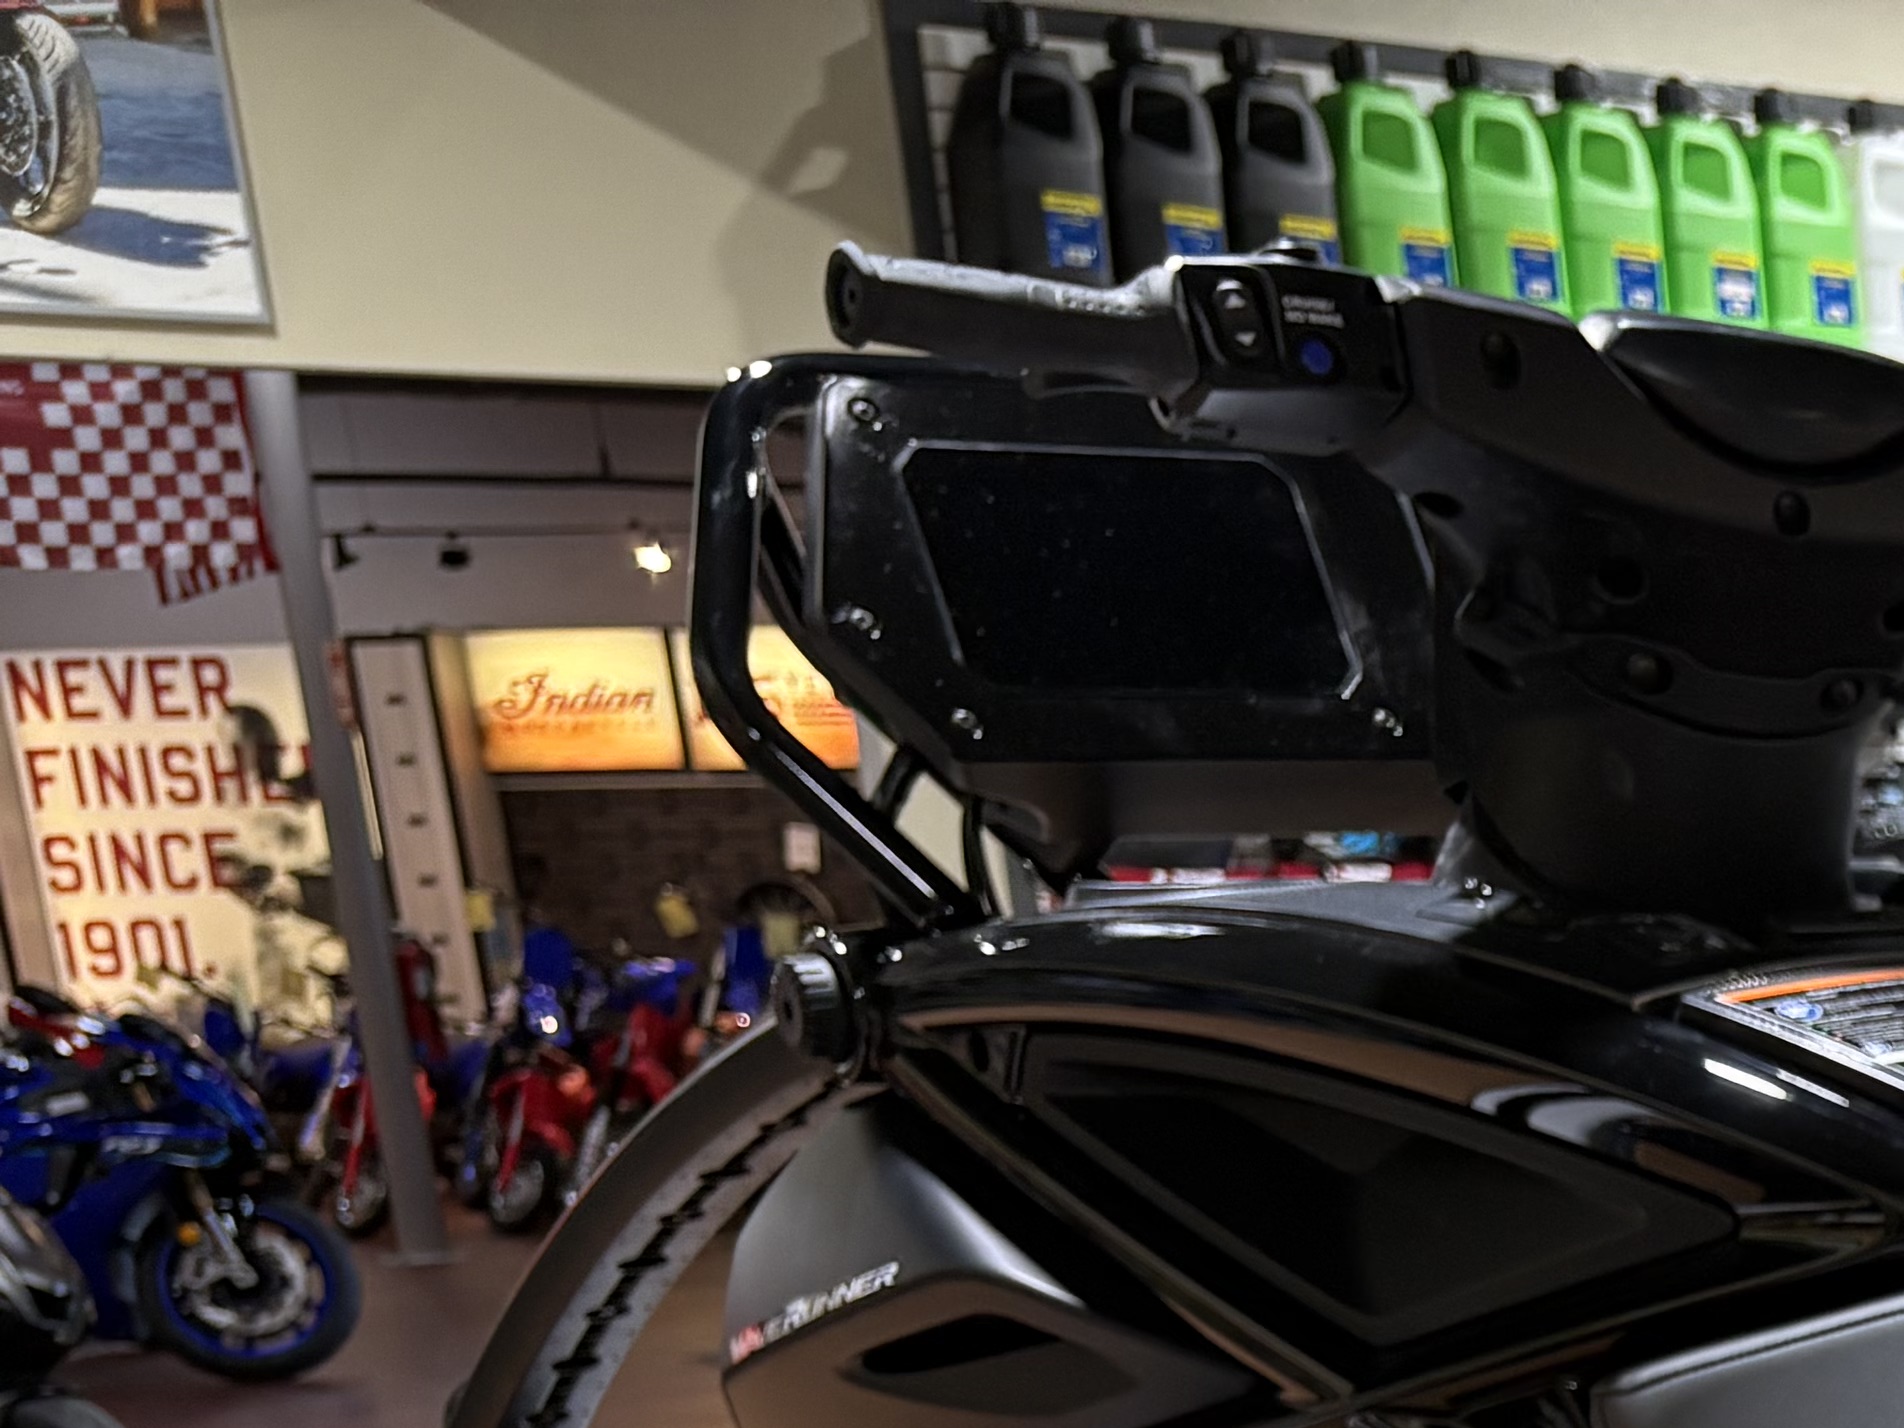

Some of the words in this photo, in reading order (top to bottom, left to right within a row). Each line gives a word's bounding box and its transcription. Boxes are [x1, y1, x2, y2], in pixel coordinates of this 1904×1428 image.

[5, 657, 232, 723] NEVER
[493, 669, 655, 721] Indian
[24, 743, 312, 809] FINISH
[43, 830, 238, 894] SINCE
[56, 916, 217, 979] 1901.
